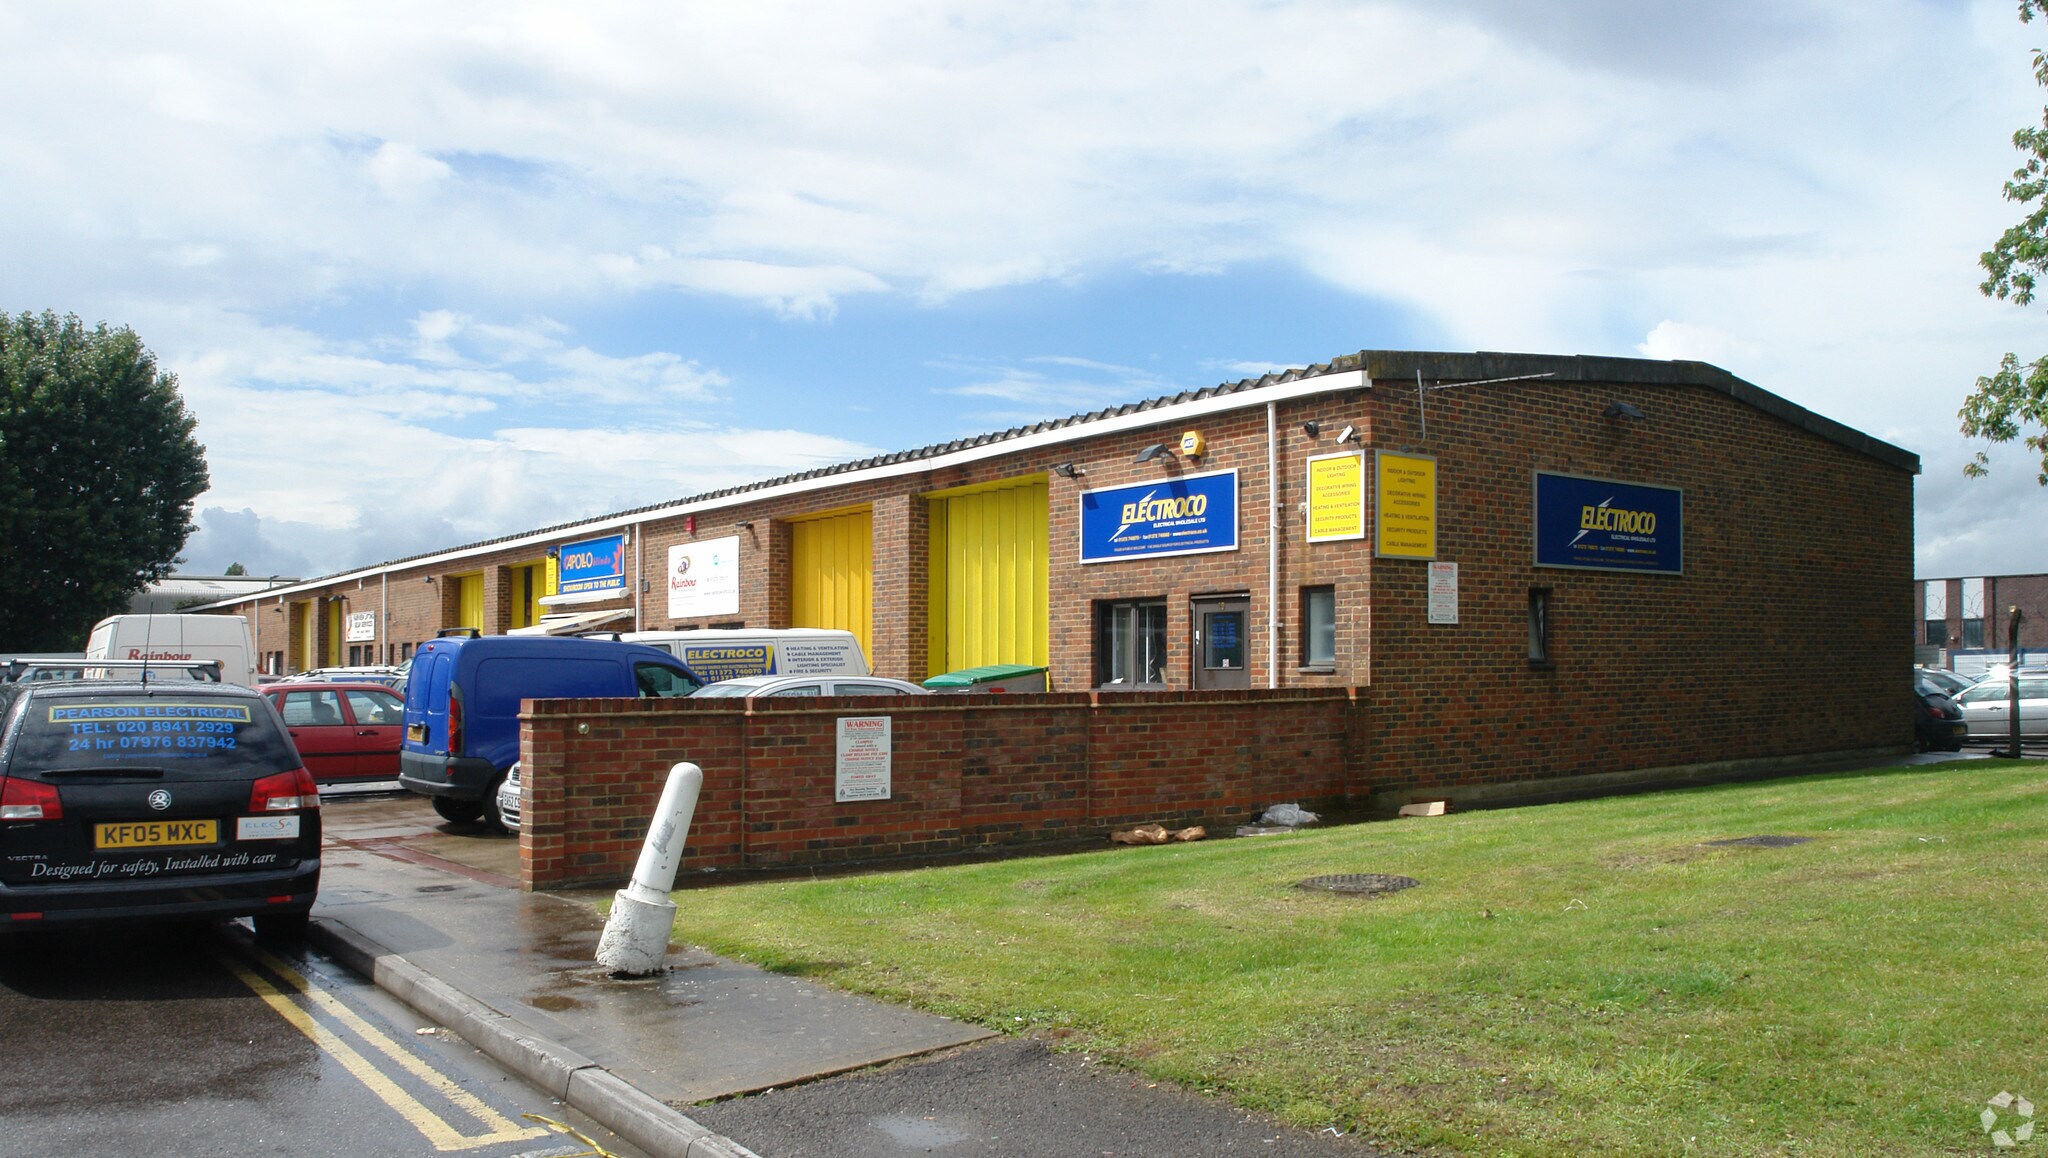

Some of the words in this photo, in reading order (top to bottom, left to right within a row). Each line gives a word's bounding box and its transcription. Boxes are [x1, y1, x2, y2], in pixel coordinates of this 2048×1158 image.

[1121, 494, 1207, 524] ELECTROCO
[1153, 520, 1175, 528] ELECTRICAL
[1581, 506, 1656, 535] ELECTROCO
[584, 582, 593, 590] OPEN
[607, 578, 620, 588] PUBLIC
[672, 576, 696, 590] Rainbow
[128, 649, 192, 660] Rainbow
[687, 648, 764, 659] ELECTROCO
[55, 707, 139, 720] PEARSON
[144, 707, 246, 720] ELECTRICAL
[70, 722, 111, 734] TEL:
[116, 722, 147, 733] 020
[152, 722, 190, 732] 8941
[196, 722, 234, 734] 2929
[69, 738, 90, 751] 24
[96, 738, 114, 749] hr
[120, 736, 172, 748] 07976
[177, 737, 236, 749] 837942
[245, 818, 292, 830] ELECSA
[104, 828, 162, 844] KF05
[167, 824, 208, 842] MXC
[32, 862, 94, 880] Designed
[96, 861, 118, 879] for
[120, 859, 160, 876] safety,
[164, 854, 220, 871] Installed
[222, 852, 250, 868] with
[252, 853, 278, 865] care
